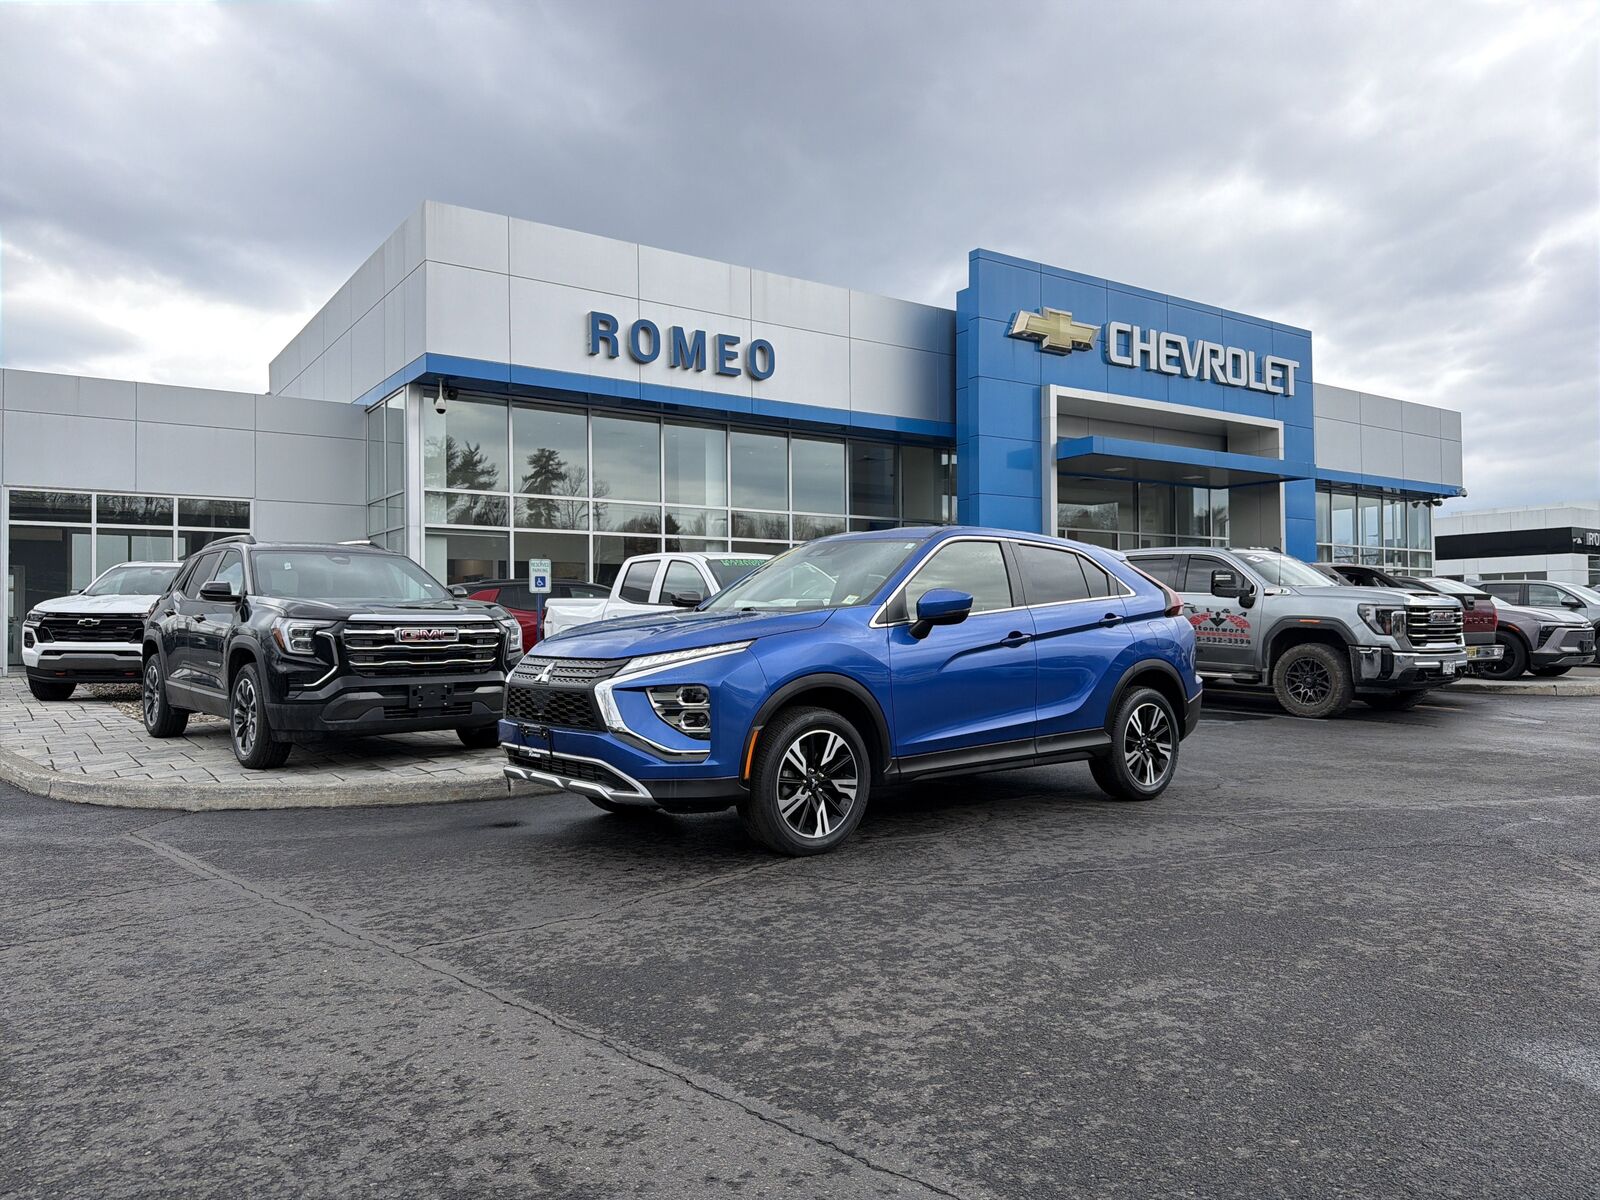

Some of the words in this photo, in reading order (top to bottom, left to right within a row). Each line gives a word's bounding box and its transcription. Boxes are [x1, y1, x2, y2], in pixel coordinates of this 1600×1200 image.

[587, 310, 776, 381] ROMEO
[1105, 320, 1300, 397] CHEVROLET
[1585, 532, 1600, 546] RO
[401, 629, 457, 640] GMC
